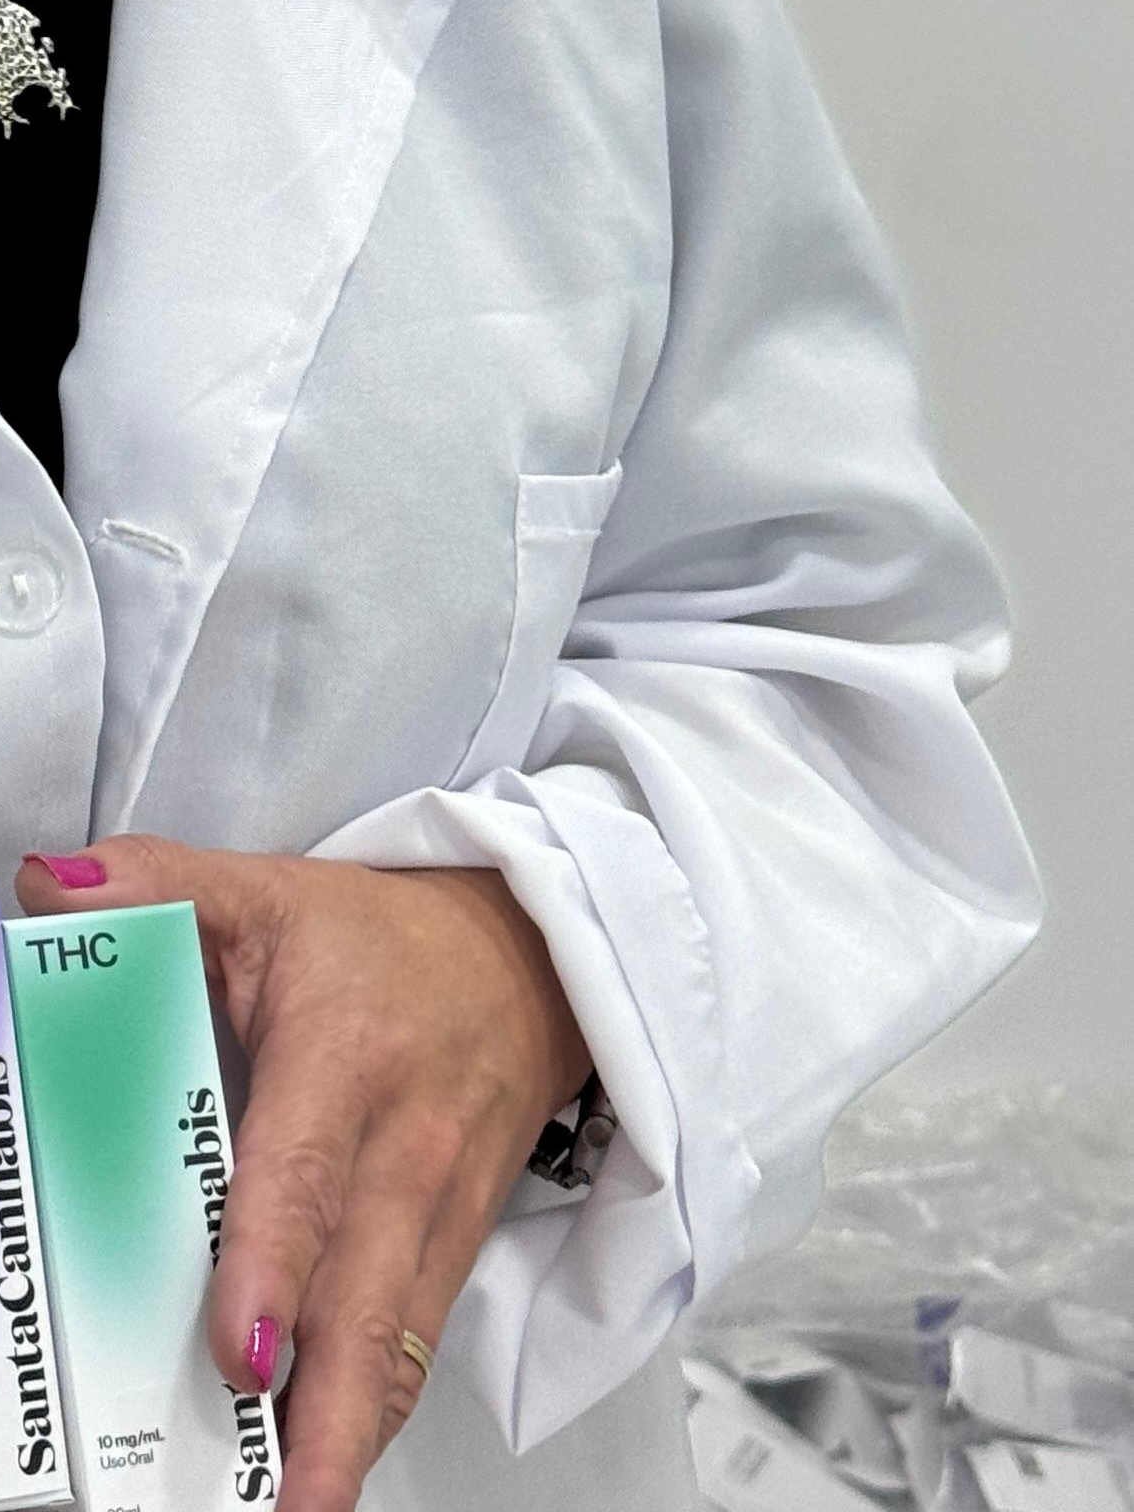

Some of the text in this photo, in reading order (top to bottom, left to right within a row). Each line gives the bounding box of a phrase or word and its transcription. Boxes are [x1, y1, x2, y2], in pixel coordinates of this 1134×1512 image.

[25, 932, 118, 975] THC
[96, 1427, 165, 1450] 10 mg/mL
[99, 1448, 154, 1470] Uso Oral
